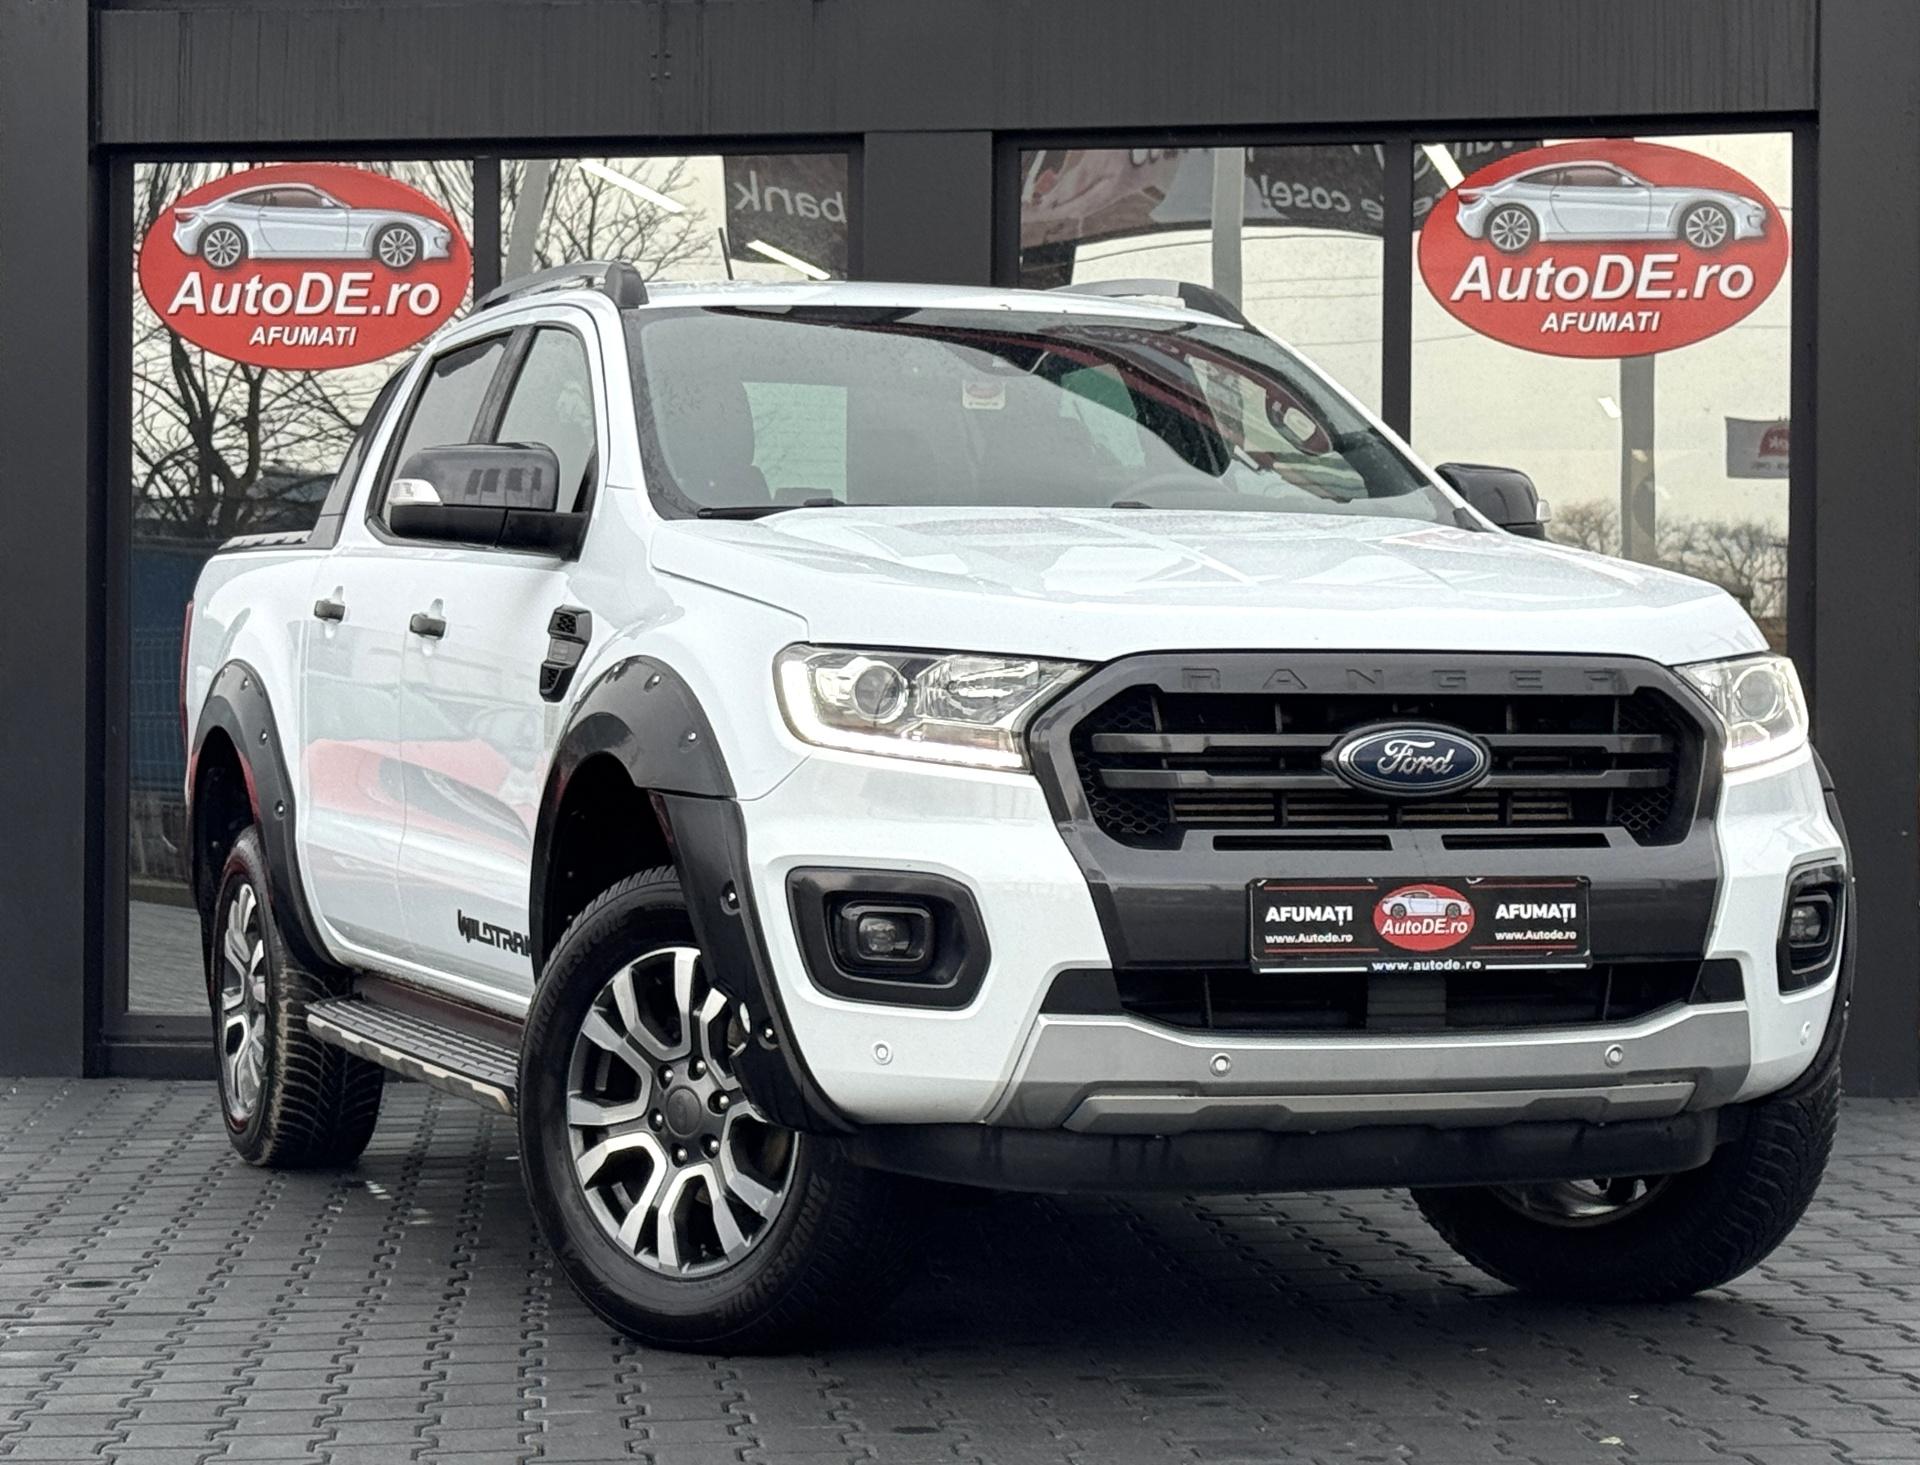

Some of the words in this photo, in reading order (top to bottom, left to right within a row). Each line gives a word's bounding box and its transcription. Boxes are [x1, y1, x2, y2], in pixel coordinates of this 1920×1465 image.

[1450, 253, 1756, 302] AutoDE.ro
[168, 271, 441, 316] AutoDE.ro
[1540, 311, 1661, 333] AFUMATI
[249, 326, 357, 347] AFUMATI
[1181, 667, 1630, 693] RANGER
[1377, 739, 1456, 776] Ford
[457, 909, 531, 957] WILDTRA
[1380, 918, 1469, 936] AutoDE.ro
[1494, 930, 1577, 941] www.Autode.ro
[1265, 933, 1354, 944] www.Autode.ro
[1371, 959, 1482, 972] www.autode.ro
